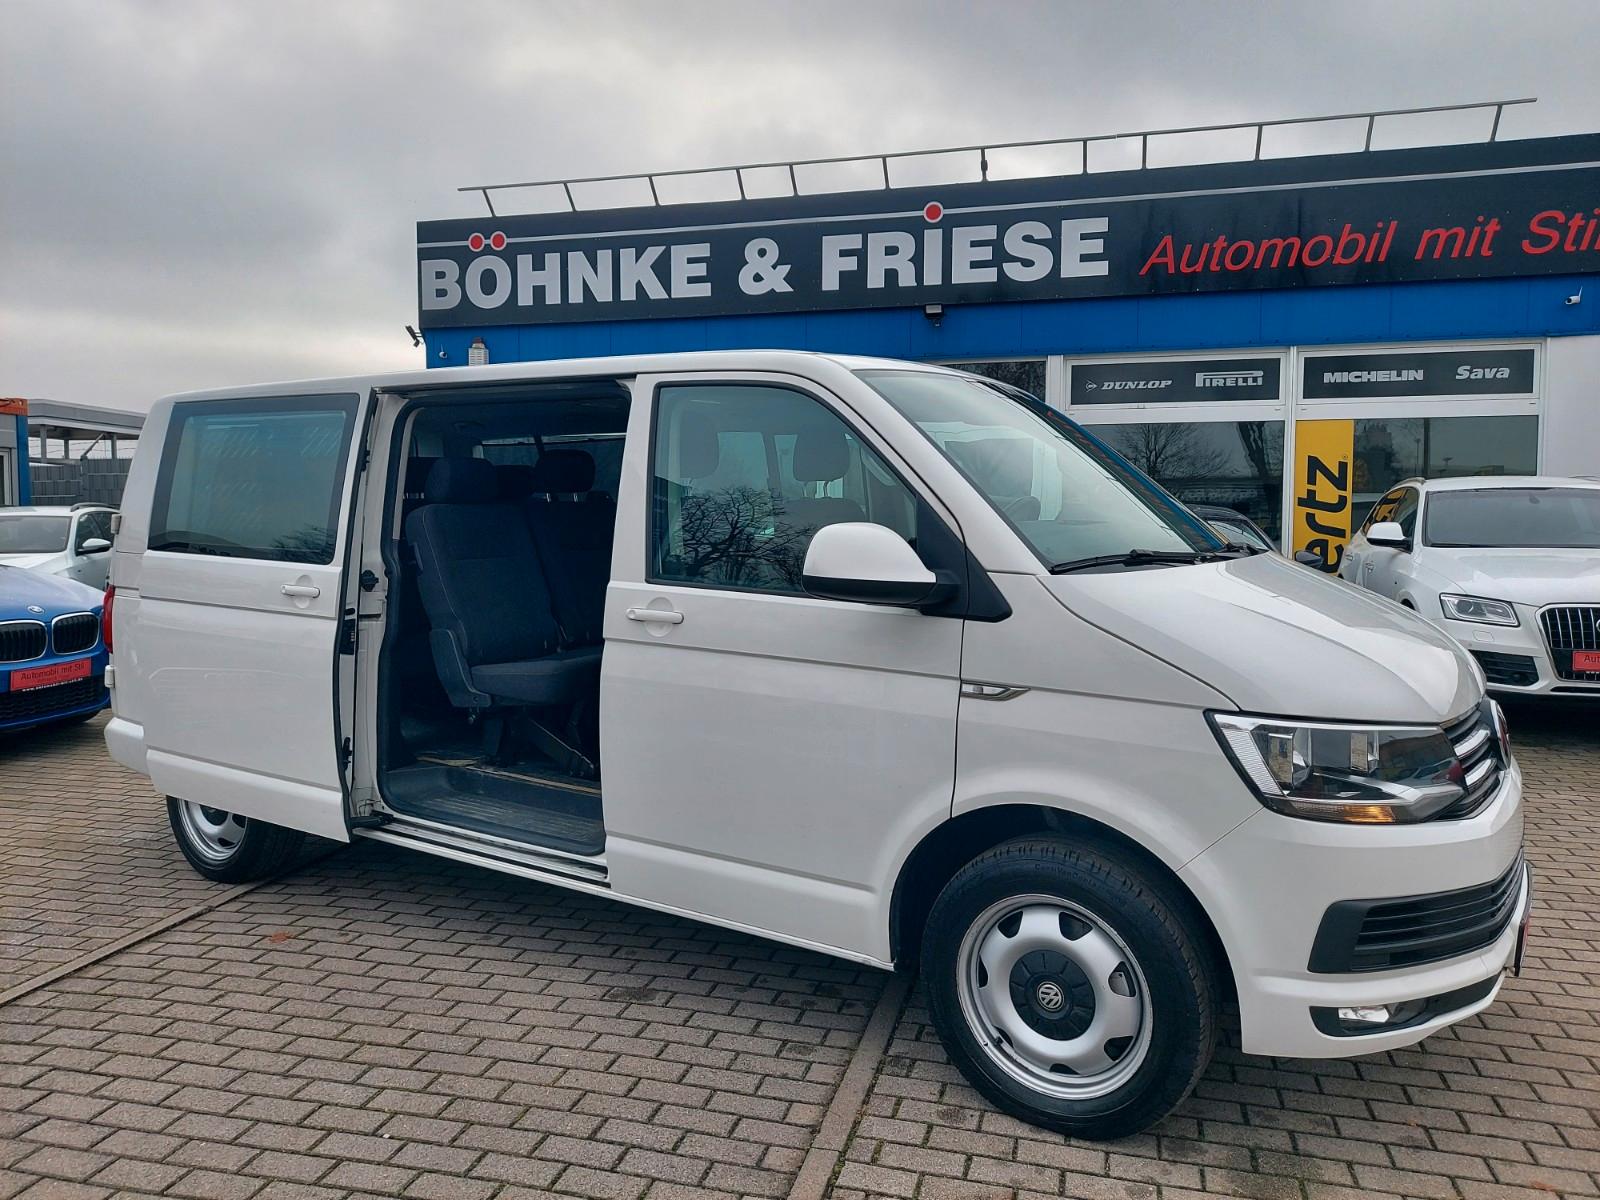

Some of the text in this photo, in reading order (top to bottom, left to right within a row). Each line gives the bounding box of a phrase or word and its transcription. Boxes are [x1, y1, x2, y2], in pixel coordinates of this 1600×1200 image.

[1139, 220, 1398, 275] Automobil
[1415, 215, 1501, 260] mit
[420, 232, 712, 311] BÖHNKE
[738, 237, 794, 296] &
[1195, 370, 1264, 388] PIRELLI
[1323, 369, 1424, 383] MICHELIN
[1455, 365, 1510, 380] Sava
[1101, 380, 1172, 390] DUNLOP
[20, 667, 59, 680] Automobil
